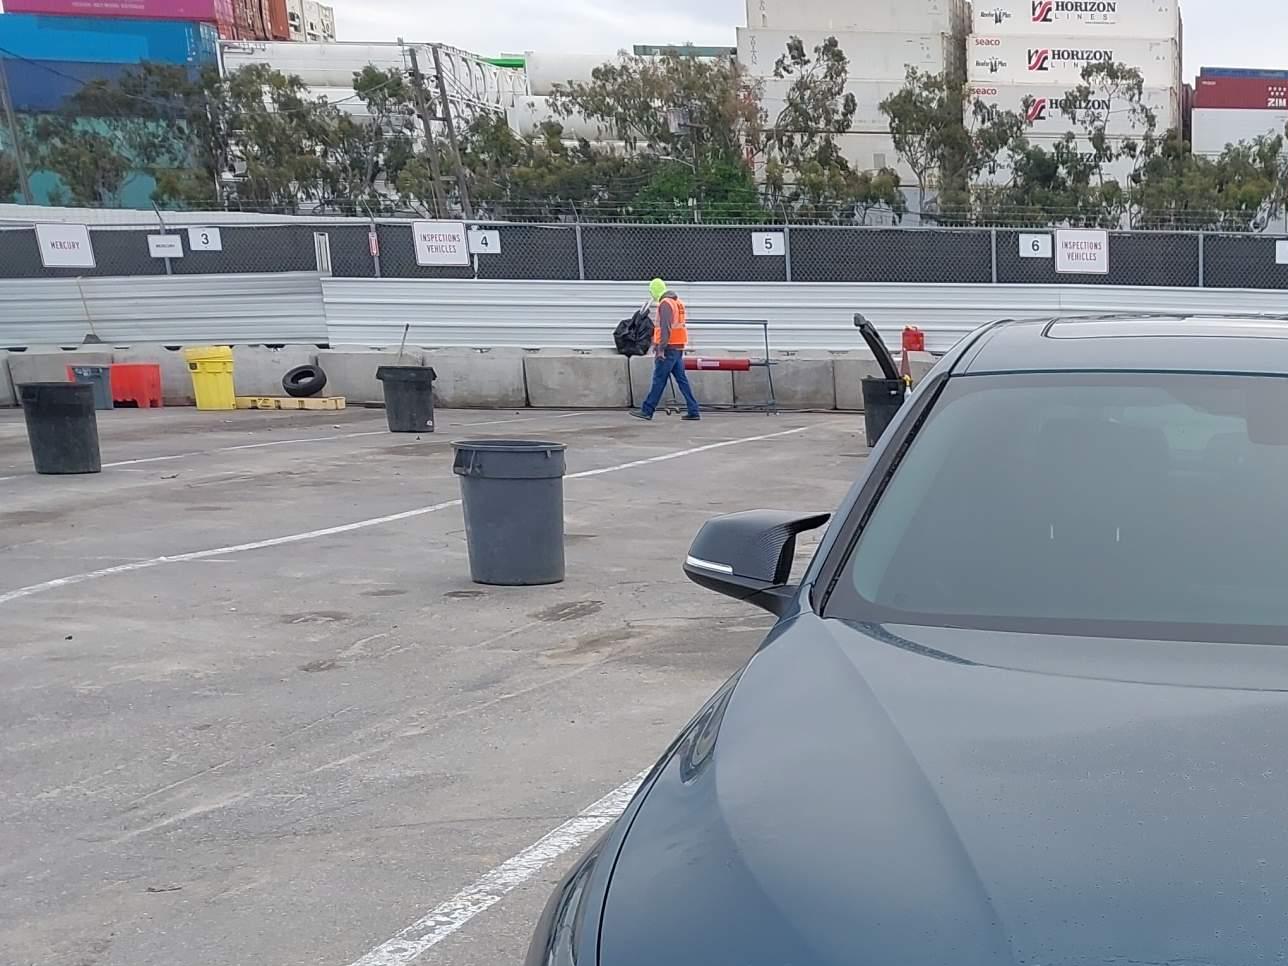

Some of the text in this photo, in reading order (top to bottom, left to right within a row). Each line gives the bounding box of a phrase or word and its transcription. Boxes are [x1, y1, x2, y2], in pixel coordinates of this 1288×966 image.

[1055, 1, 1116, 12] HORIZON
[975, 38, 1000, 46] seaco
[1052, 49, 1113, 61] HORIZON
[1267, 98, 1287, 107] ZIM
[201, 233, 209, 245] 3
[420, 233, 461, 243] INSPECTIONS
[480, 235, 489, 248] 4
[764, 237, 773, 250] 5
[50, 239, 80, 250] MERCURY
[427, 244, 457, 254] VEHICLES
[1031, 239, 1040, 252] 6
[1061, 240, 1102, 251] INSPECTIONS
[1066, 251, 1097, 262] VEHICLES
